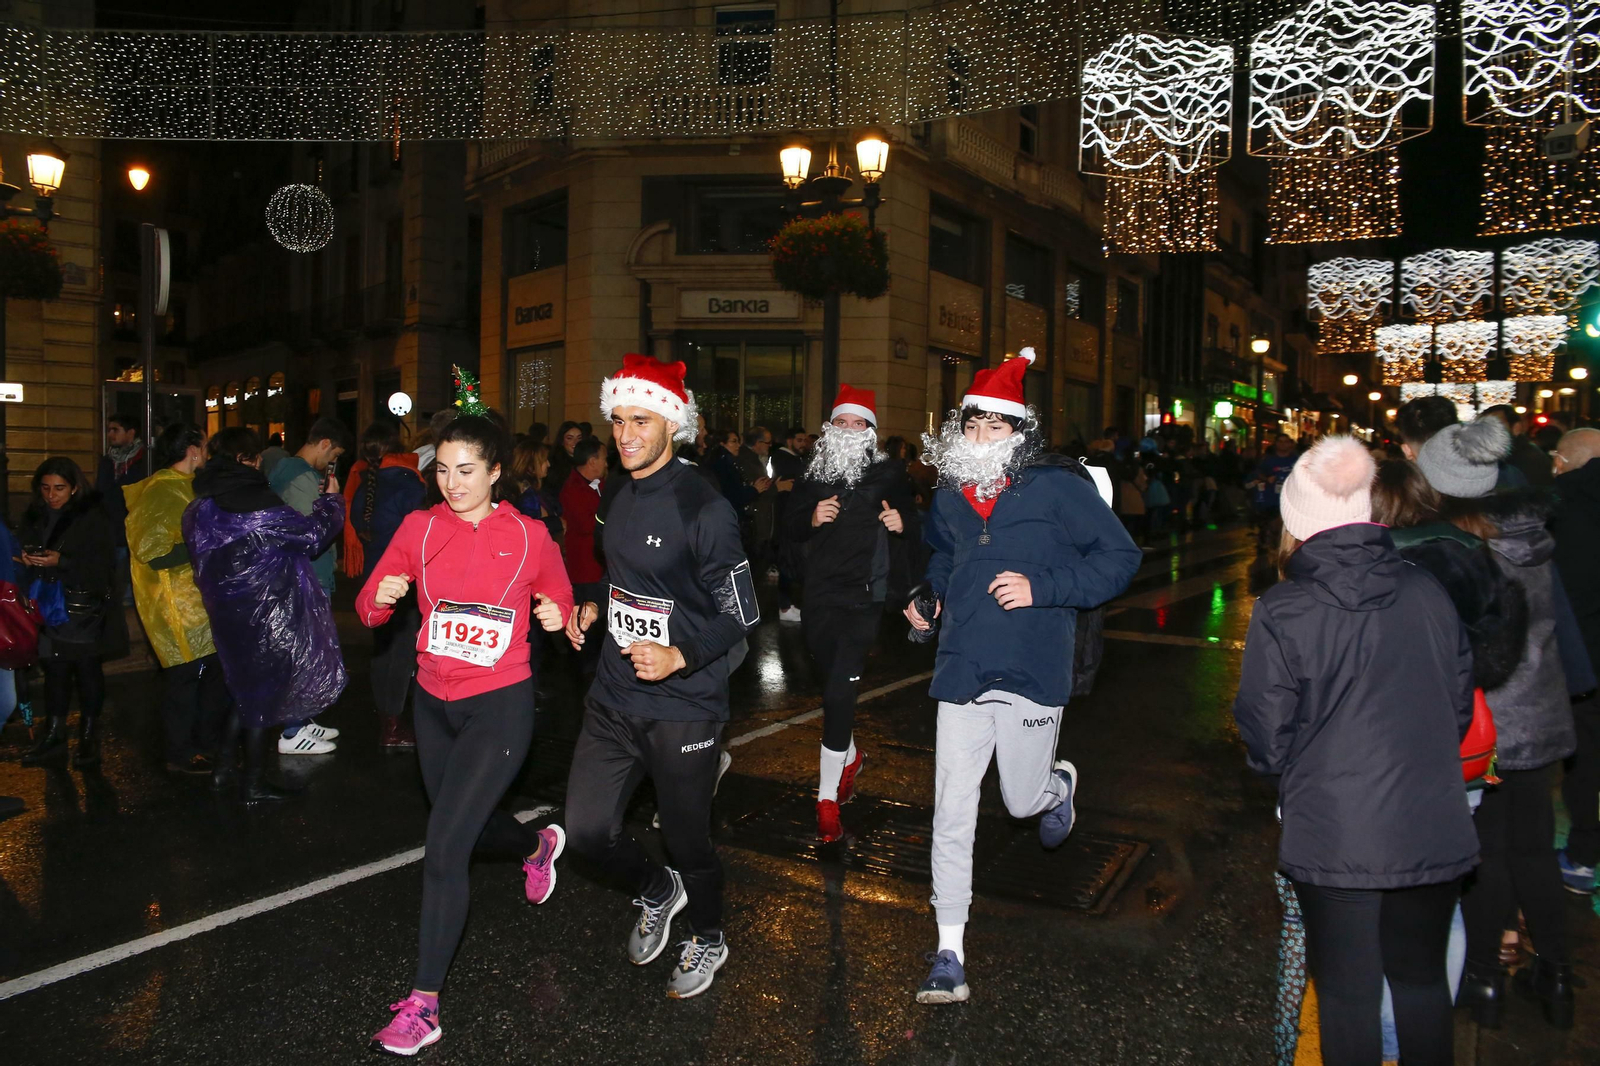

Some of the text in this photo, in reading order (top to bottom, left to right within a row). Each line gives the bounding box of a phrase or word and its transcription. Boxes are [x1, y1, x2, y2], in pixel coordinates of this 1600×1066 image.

[708, 297, 770, 314] Bankia
[441, 620, 500, 649] 1923
[613, 610, 662, 638] 1935
[1022, 715, 1055, 728] NASA
